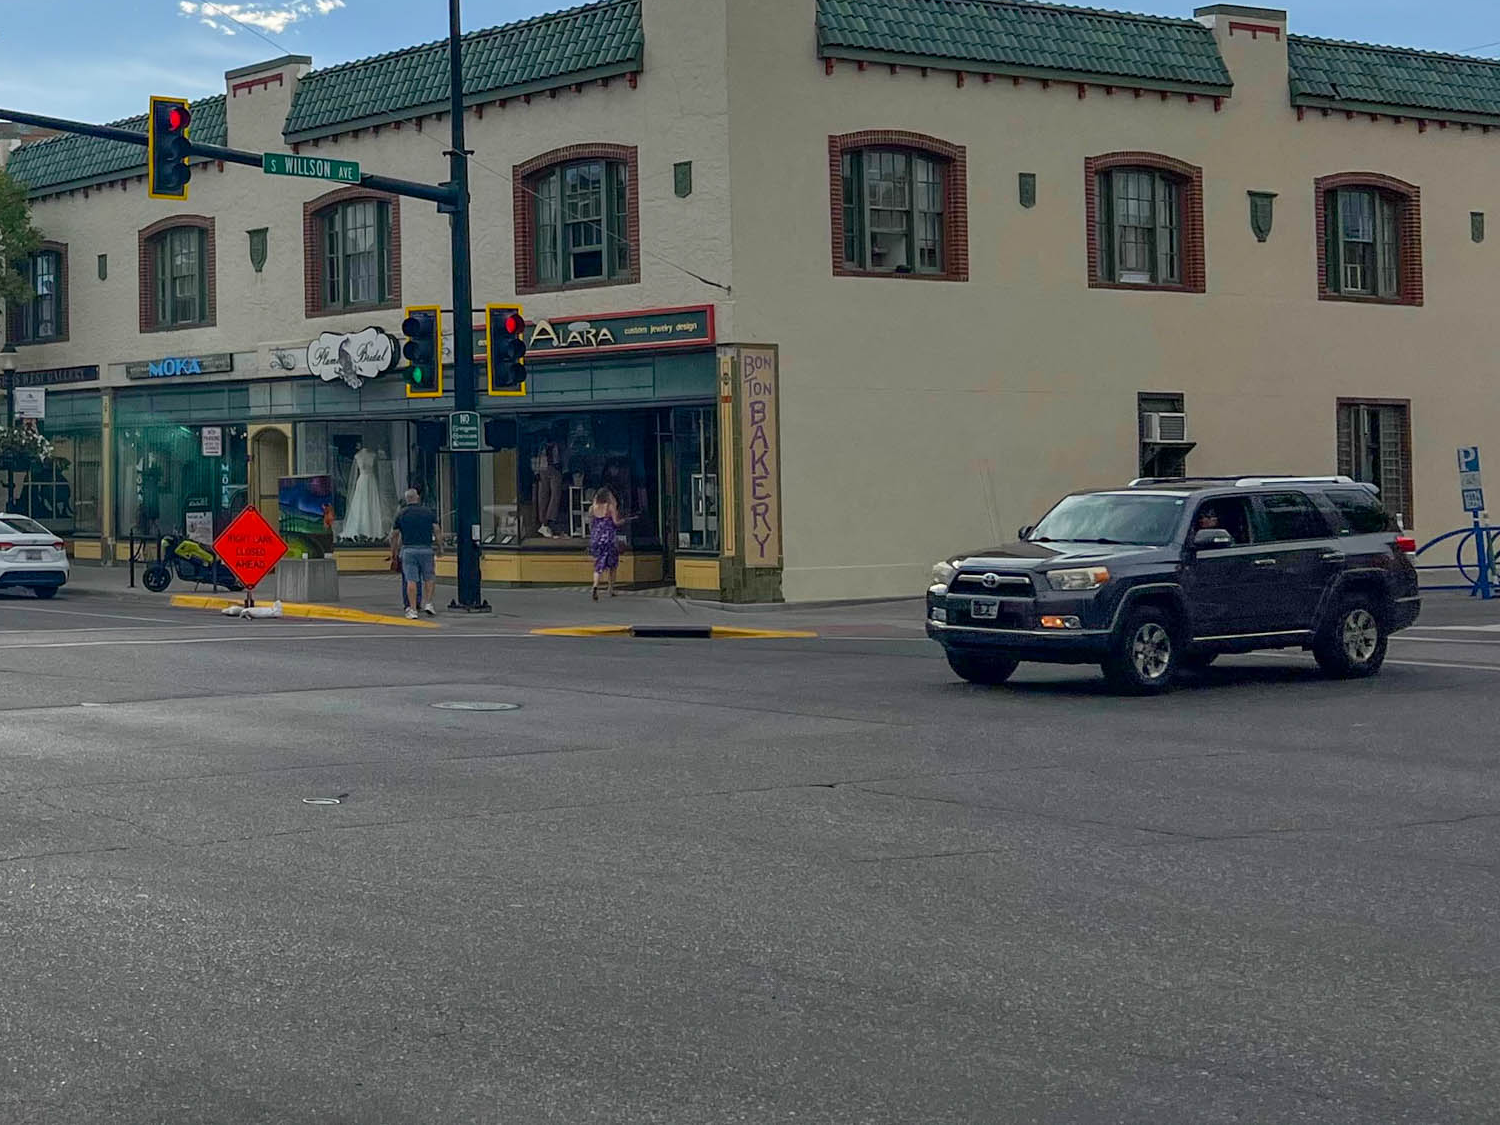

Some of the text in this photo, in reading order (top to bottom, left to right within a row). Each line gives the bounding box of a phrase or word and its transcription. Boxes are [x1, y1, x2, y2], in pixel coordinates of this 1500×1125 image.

[270, 156, 353, 180] S WILLSON AVE
[529, 319, 616, 347] ALARA
[675, 322, 698, 332] design
[353, 340, 390, 364] Bridal
[743, 354, 772, 378] BON
[743, 377, 772, 398] TON
[1460, 448, 1476, 471] P
[749, 400, 772, 559] BAKERY
[228, 535, 249, 543] RIGHT
[236, 546, 266, 555] CLOSED
[236, 559, 266, 569] AHEAD
